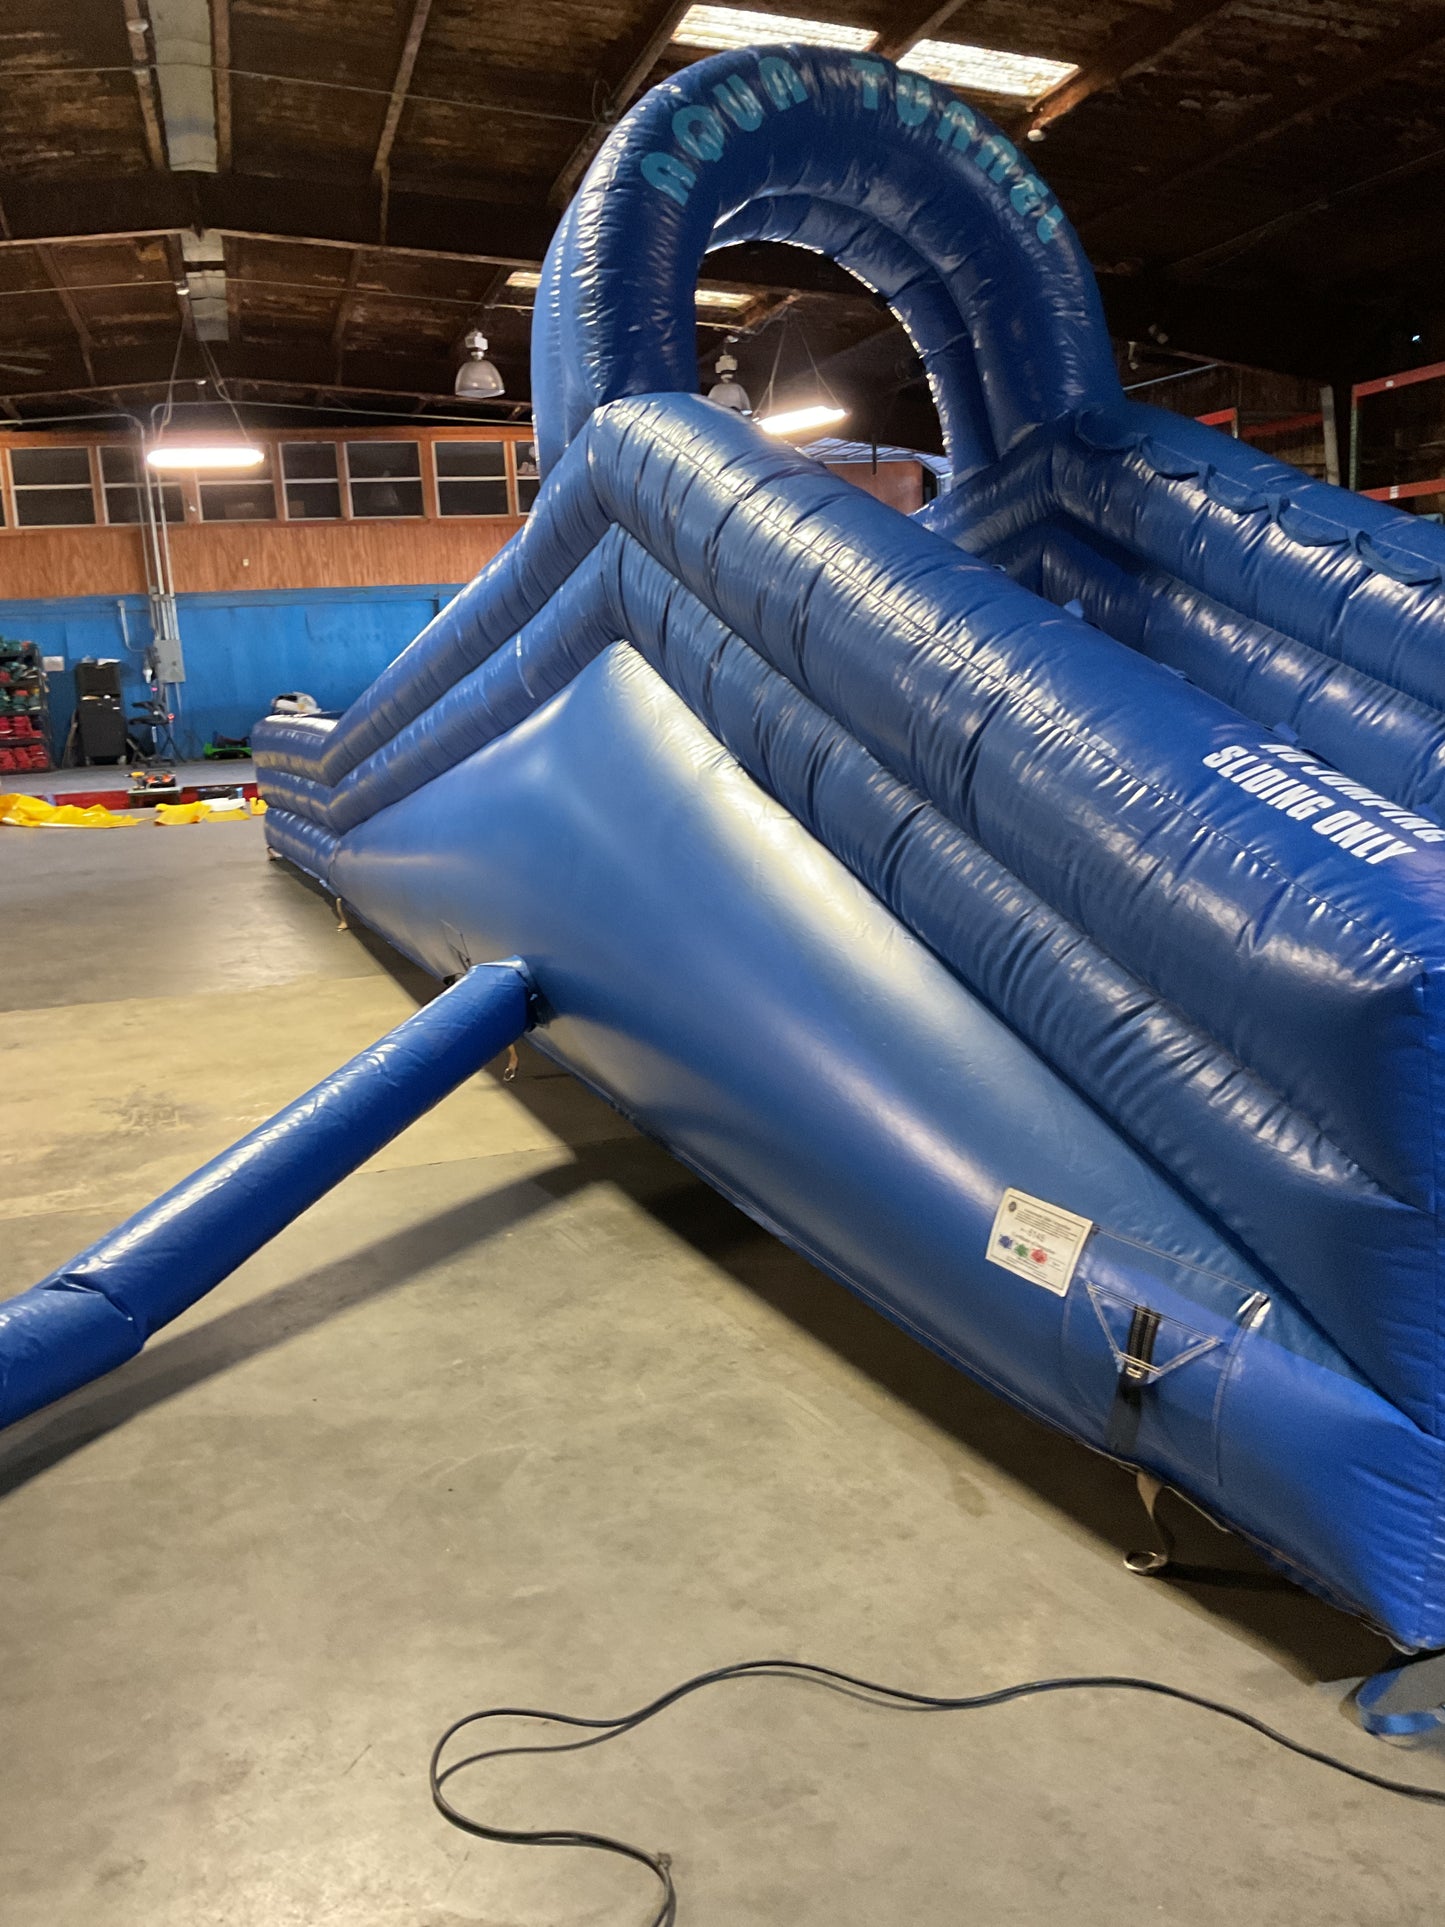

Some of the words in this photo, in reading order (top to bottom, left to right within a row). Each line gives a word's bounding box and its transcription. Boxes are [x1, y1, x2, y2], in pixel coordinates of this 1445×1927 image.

[641, 57, 808, 205] AQUA
[1202, 745, 1336, 821] SLIDING
[1311, 810, 1417, 865] ONLY
[1300, 765, 1445, 842] JUMPING
